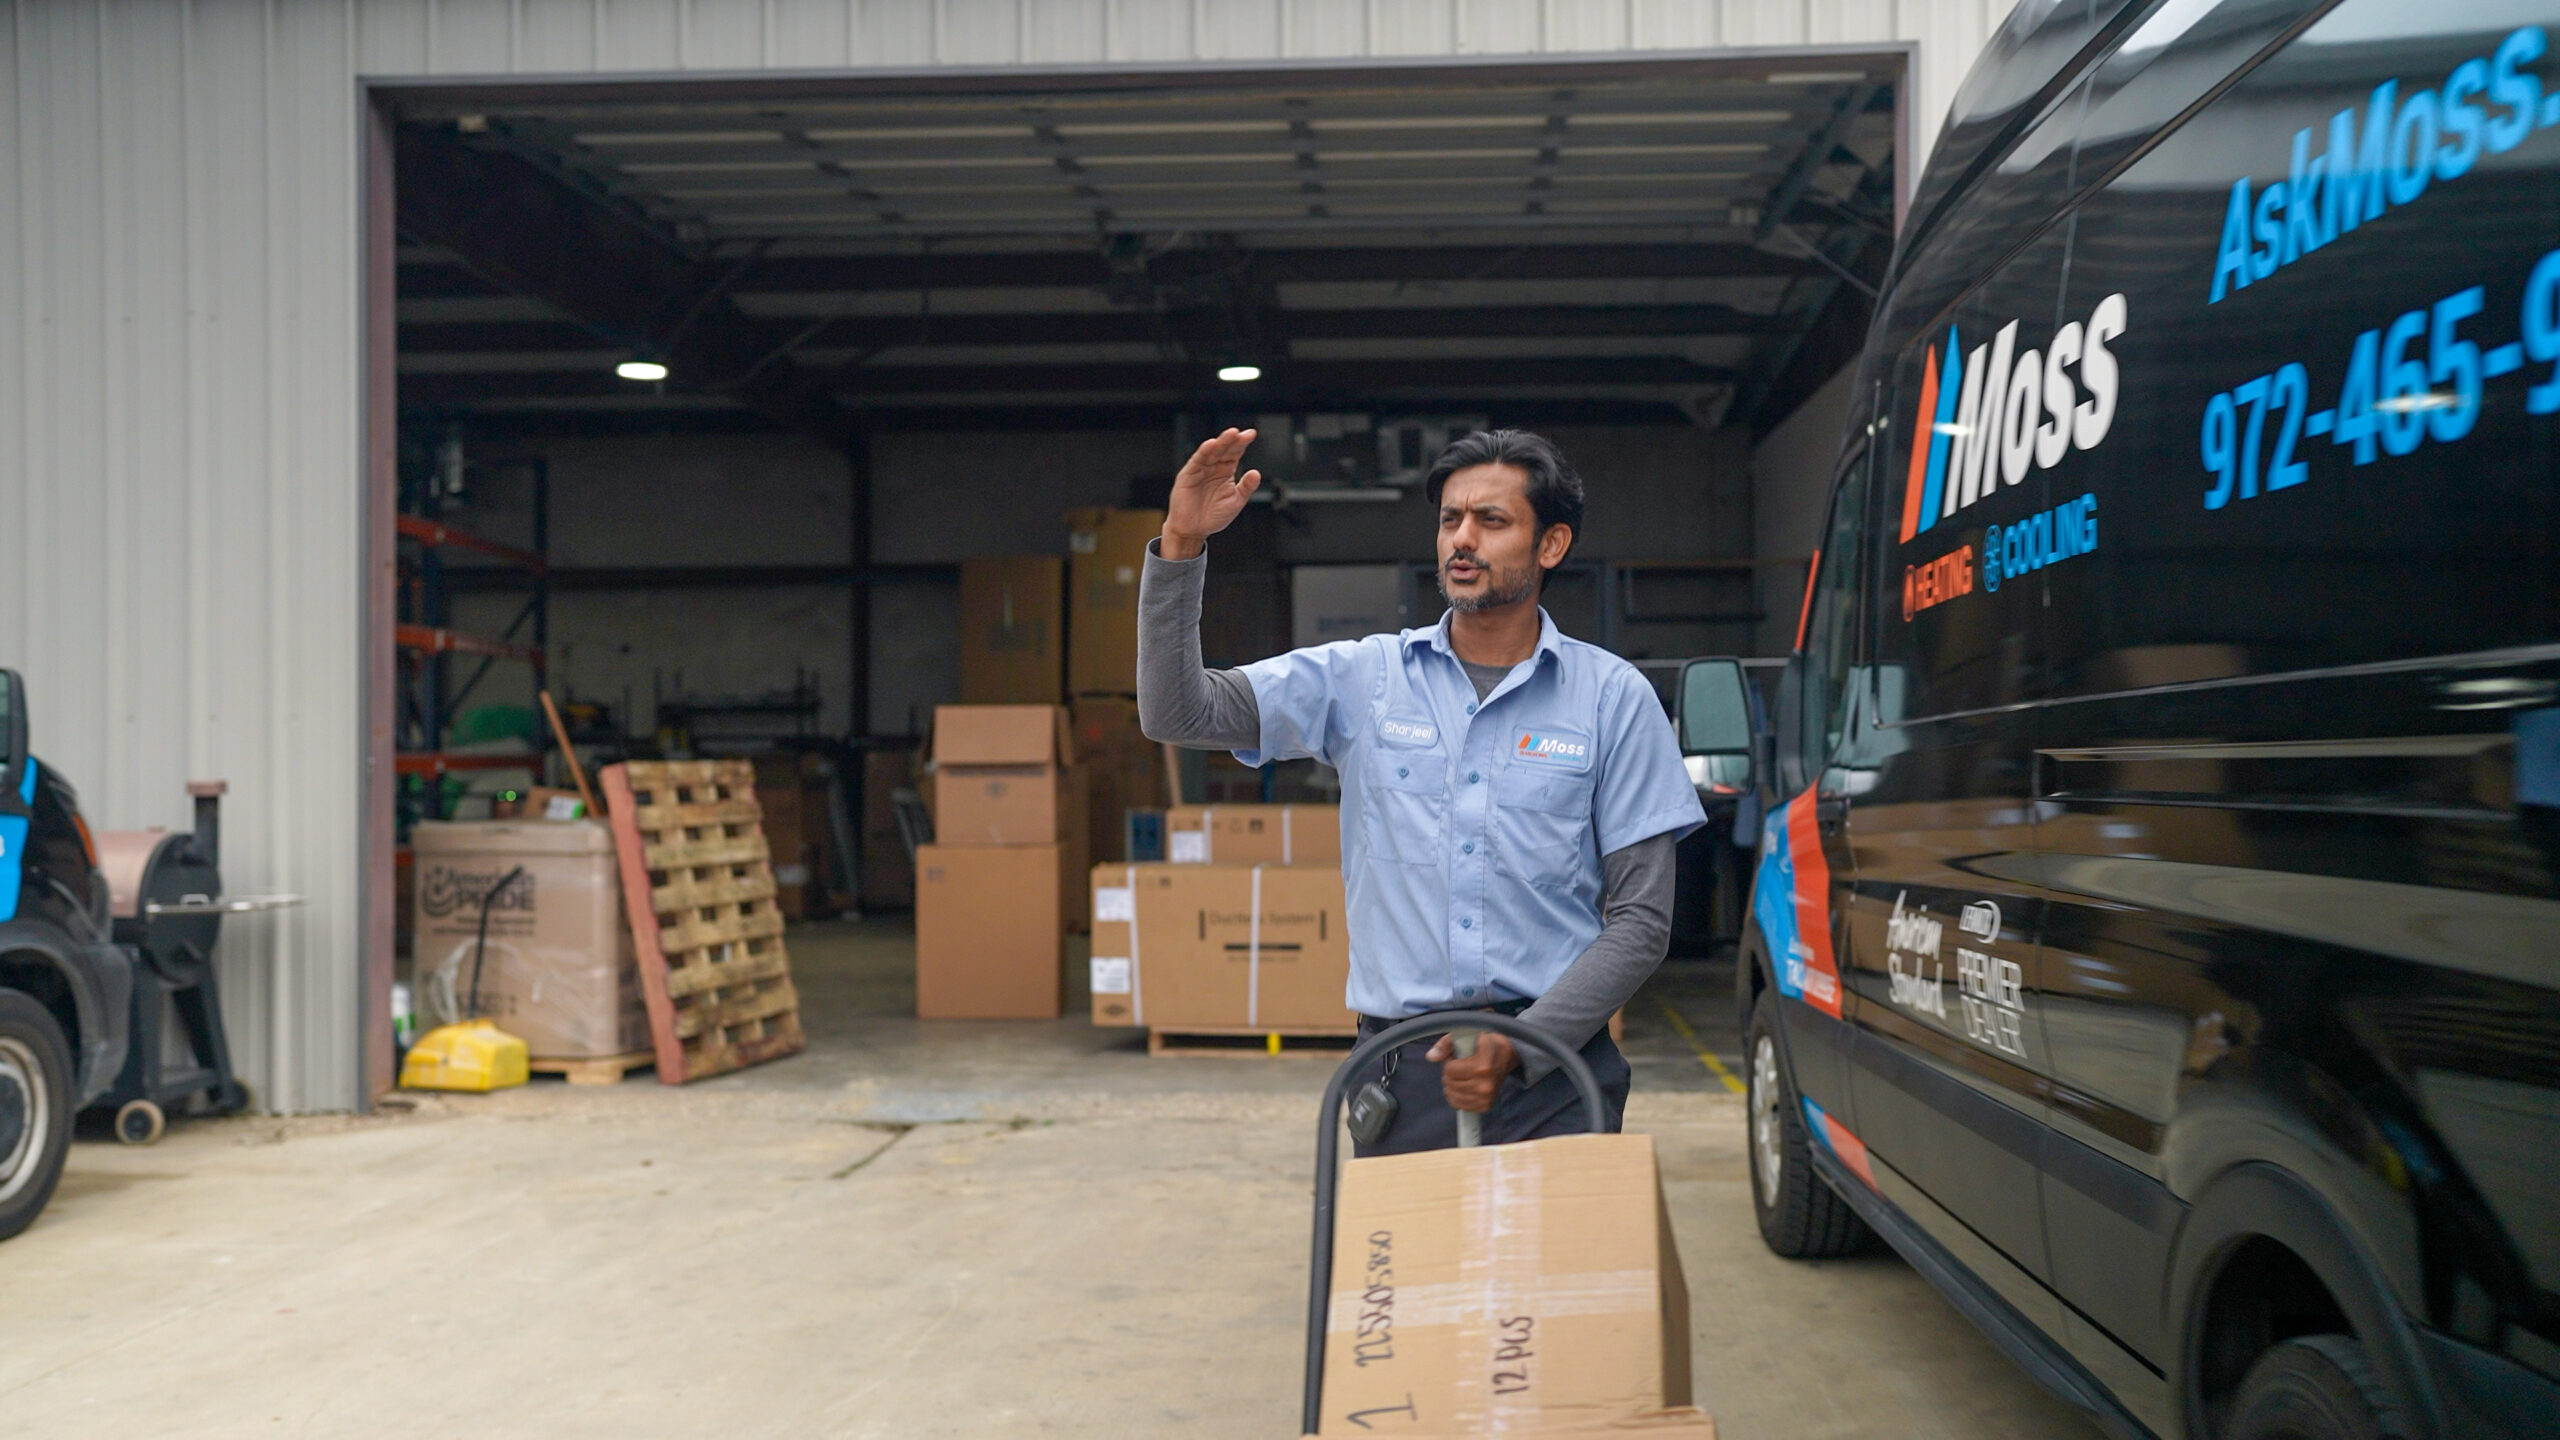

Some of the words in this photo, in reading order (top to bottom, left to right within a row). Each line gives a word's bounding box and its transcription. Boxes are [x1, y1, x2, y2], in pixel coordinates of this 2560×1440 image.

[1943, 293, 2127, 518] Moss
[1915, 545, 1973, 612] HEATING
[2002, 493, 2098, 579] COOLING
[1384, 721, 1432, 739] Sharjeel
[1538, 738, 1585, 756] Moss
[1492, 1363, 1529, 1395] 12
[1346, 1391, 1418, 1429] 1
